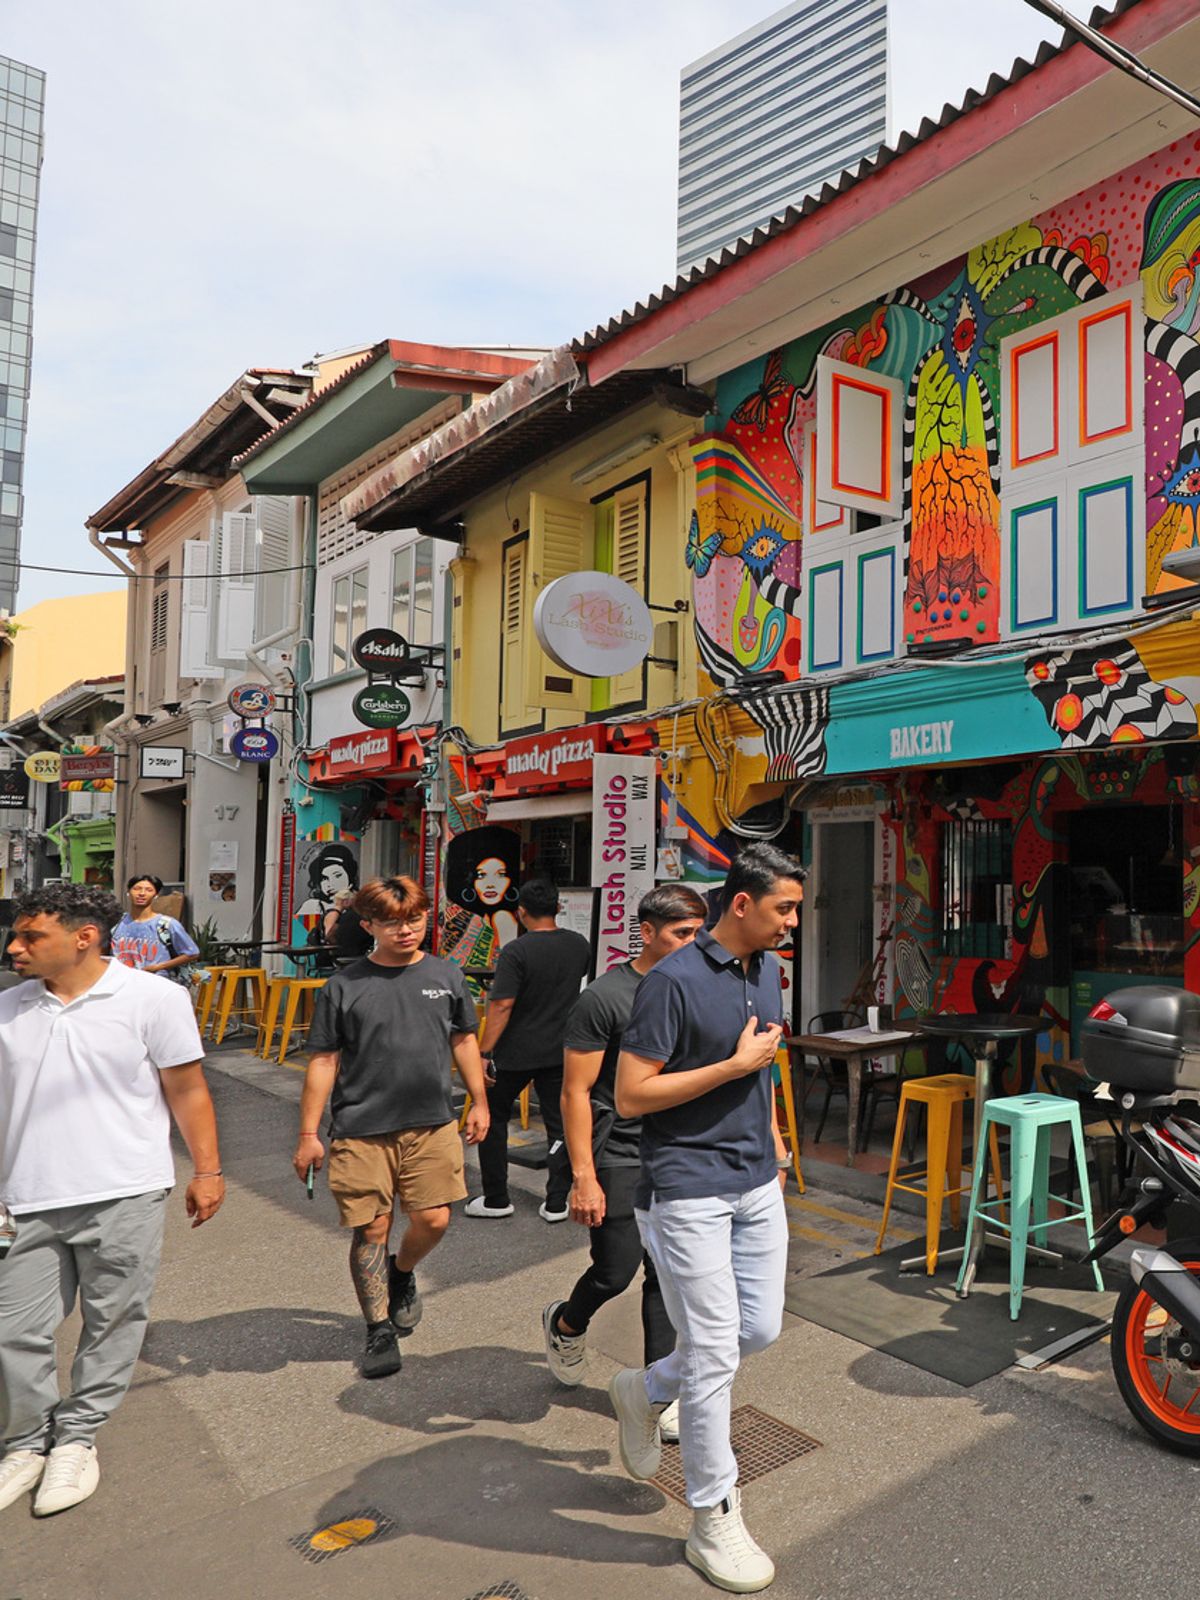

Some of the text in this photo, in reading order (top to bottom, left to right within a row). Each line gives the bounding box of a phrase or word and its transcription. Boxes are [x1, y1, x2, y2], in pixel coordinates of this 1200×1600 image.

[595, 623, 647, 642] Studio
[361, 640, 405, 658] Asahi
[360, 698, 407, 714] Carlsberg
[359, 735, 388, 765] pizza
[890, 720, 954, 760] BAKERY
[551, 736, 594, 776] pizza
[631, 775, 648, 800] WAX
[214, 804, 240, 821] 17
[602, 775, 628, 863] Studio
[630, 844, 647, 871] NAIL
[601, 872, 626, 935] Lash
